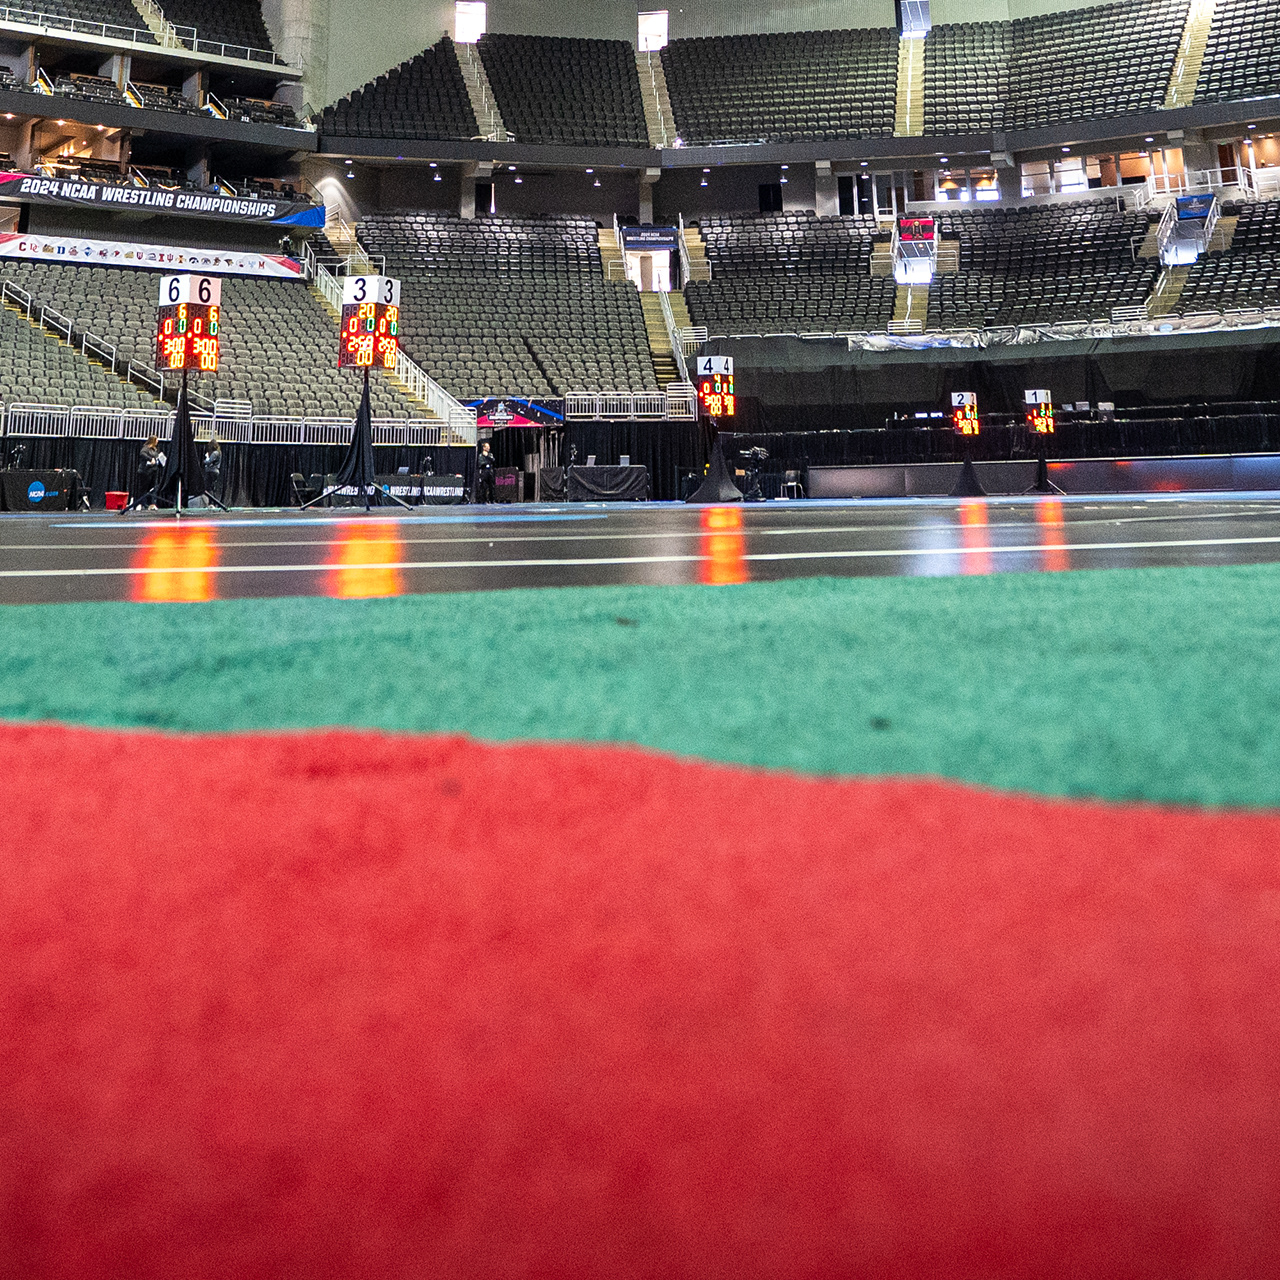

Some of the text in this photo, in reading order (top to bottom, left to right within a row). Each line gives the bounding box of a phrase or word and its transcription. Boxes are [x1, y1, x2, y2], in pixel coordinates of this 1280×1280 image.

[20, 178, 59, 196] 2024
[101, 186, 174, 207] WRESTLING
[176, 195, 276, 217] CHAMPIONSHIPS
[18, 242, 27, 251] C
[168, 277, 180, 302] 6
[198, 278, 211, 303] 6
[353, 277, 366, 302] 3
[384, 279, 393, 304] 3
[179, 303, 187, 319] 6
[209, 306, 218, 321] 6
[359, 303, 375, 319] 20
[385, 305, 398, 321] 20
[164, 318, 187, 335] 0 0
[193, 318, 218, 336] 0 0
[349, 317, 375, 333] 0 0
[379, 318, 398, 336] 0 0
[163, 336, 186, 354] 3:00
[193, 337, 217, 355] 3:00
[378, 336, 396, 354] 2:59
[170, 352, 184, 368] 00
[201, 353, 217, 370] 00
[357, 350, 373, 365] 00
[384, 352, 396, 368] 00
[703, 357, 713, 373] 4
[724, 357, 729, 373] 4
[703, 382, 721, 394] 0 0
[957, 393, 965, 405] 2
[1031, 390, 1037, 403] 1
[390, 485, 422, 497] WRESTLING
